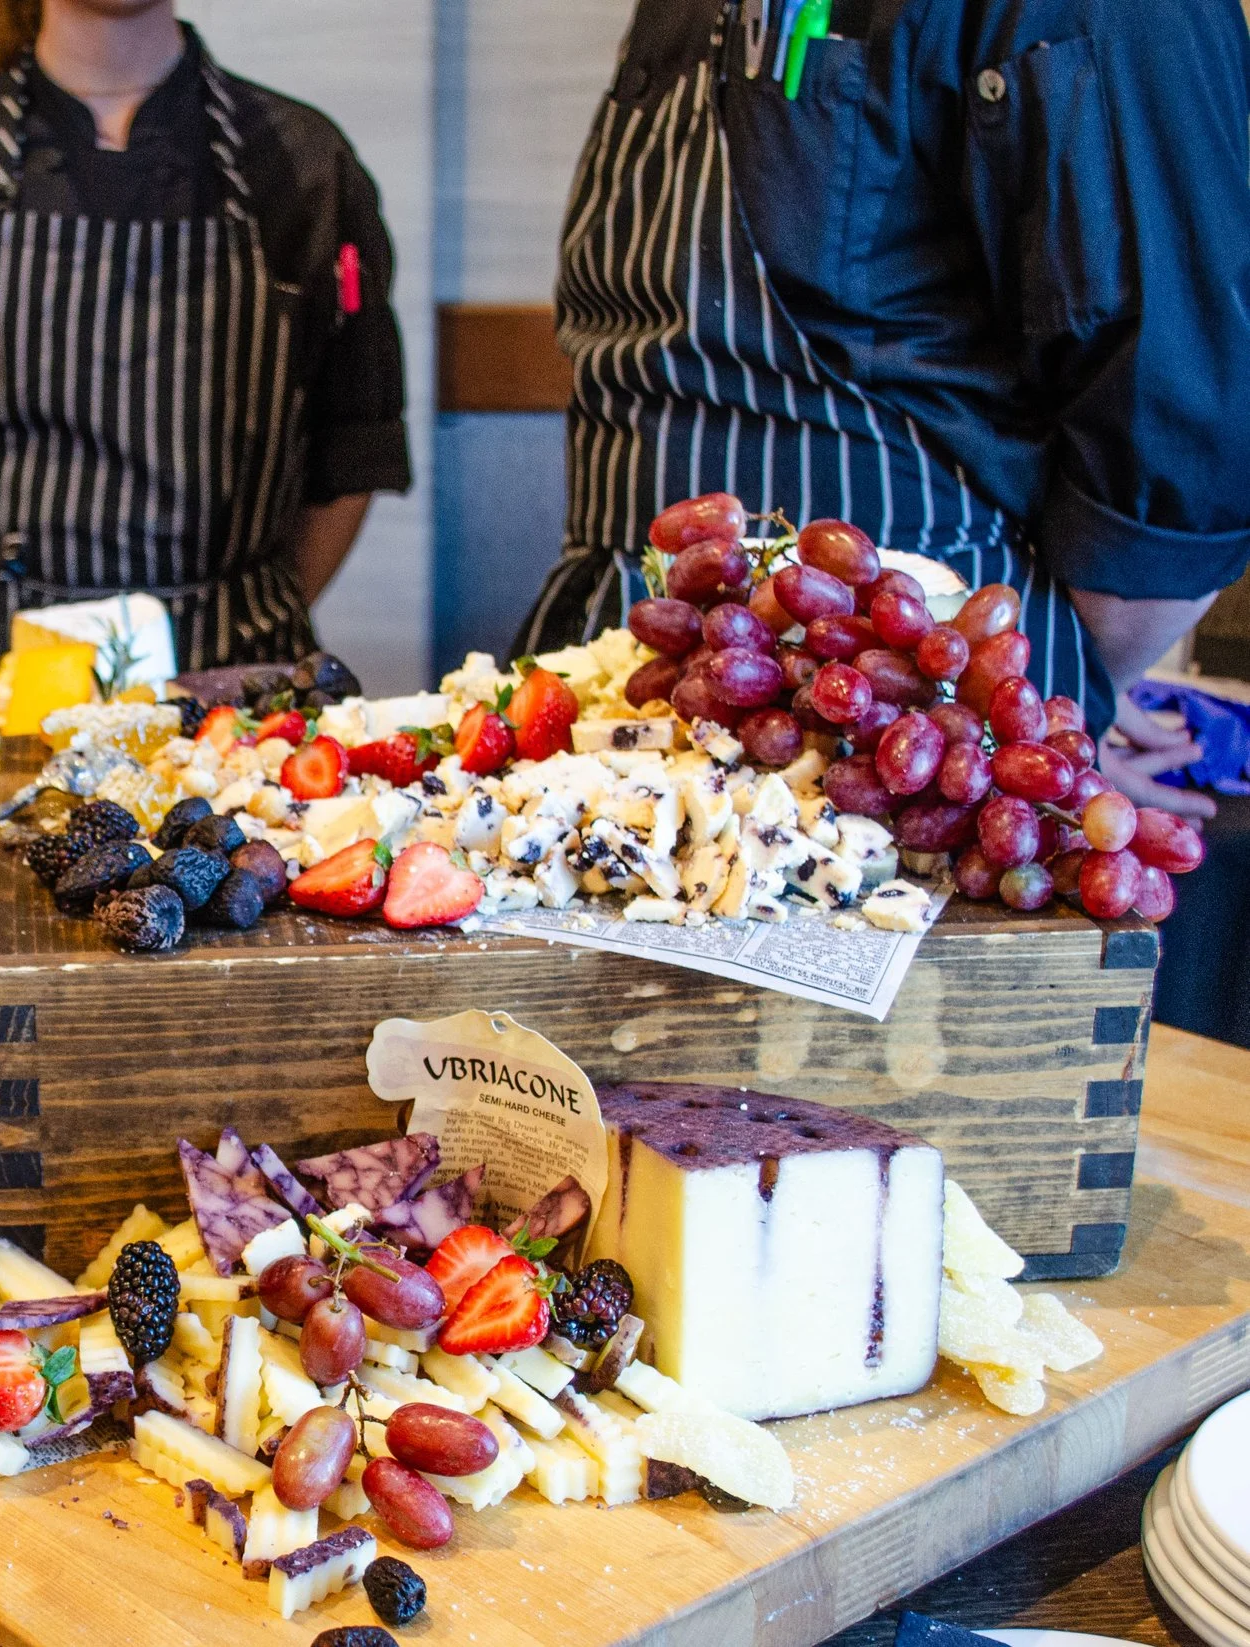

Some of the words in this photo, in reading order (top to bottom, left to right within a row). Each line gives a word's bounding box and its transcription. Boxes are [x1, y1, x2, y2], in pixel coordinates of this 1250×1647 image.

[423, 1056, 581, 1115] UBRIACONE
[478, 1093, 530, 1114] SEMI-HARD
[532, 1108, 566, 1127] CHEESE
